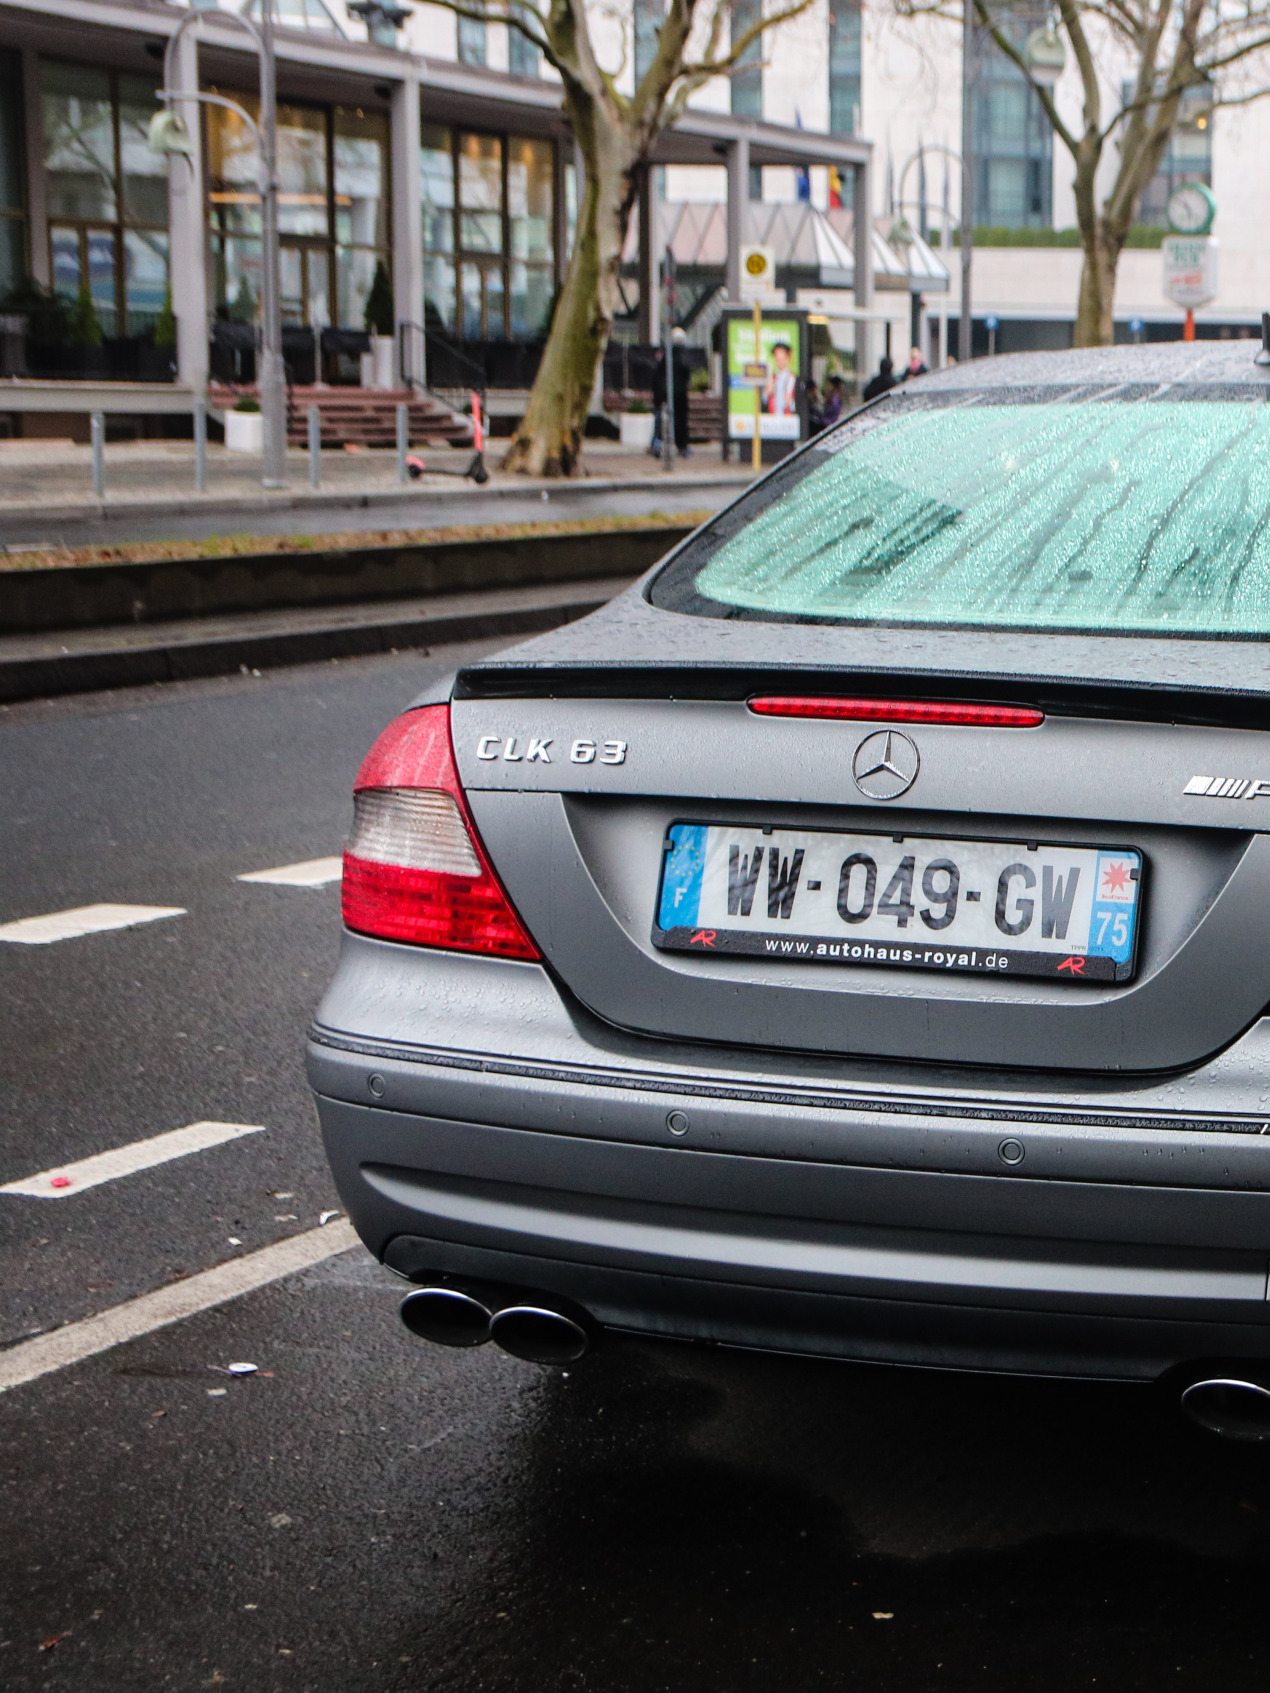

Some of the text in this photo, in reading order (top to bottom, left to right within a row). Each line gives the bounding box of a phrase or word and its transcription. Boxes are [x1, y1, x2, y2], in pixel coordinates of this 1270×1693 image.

[476, 736, 627, 765] CLK 63
[673, 887, 687, 908] F
[727, 844, 1081, 940] WW-049-GW
[1096, 911, 1128, 947] 75
[765, 938, 1009, 969] www.autohaus-royal.de
